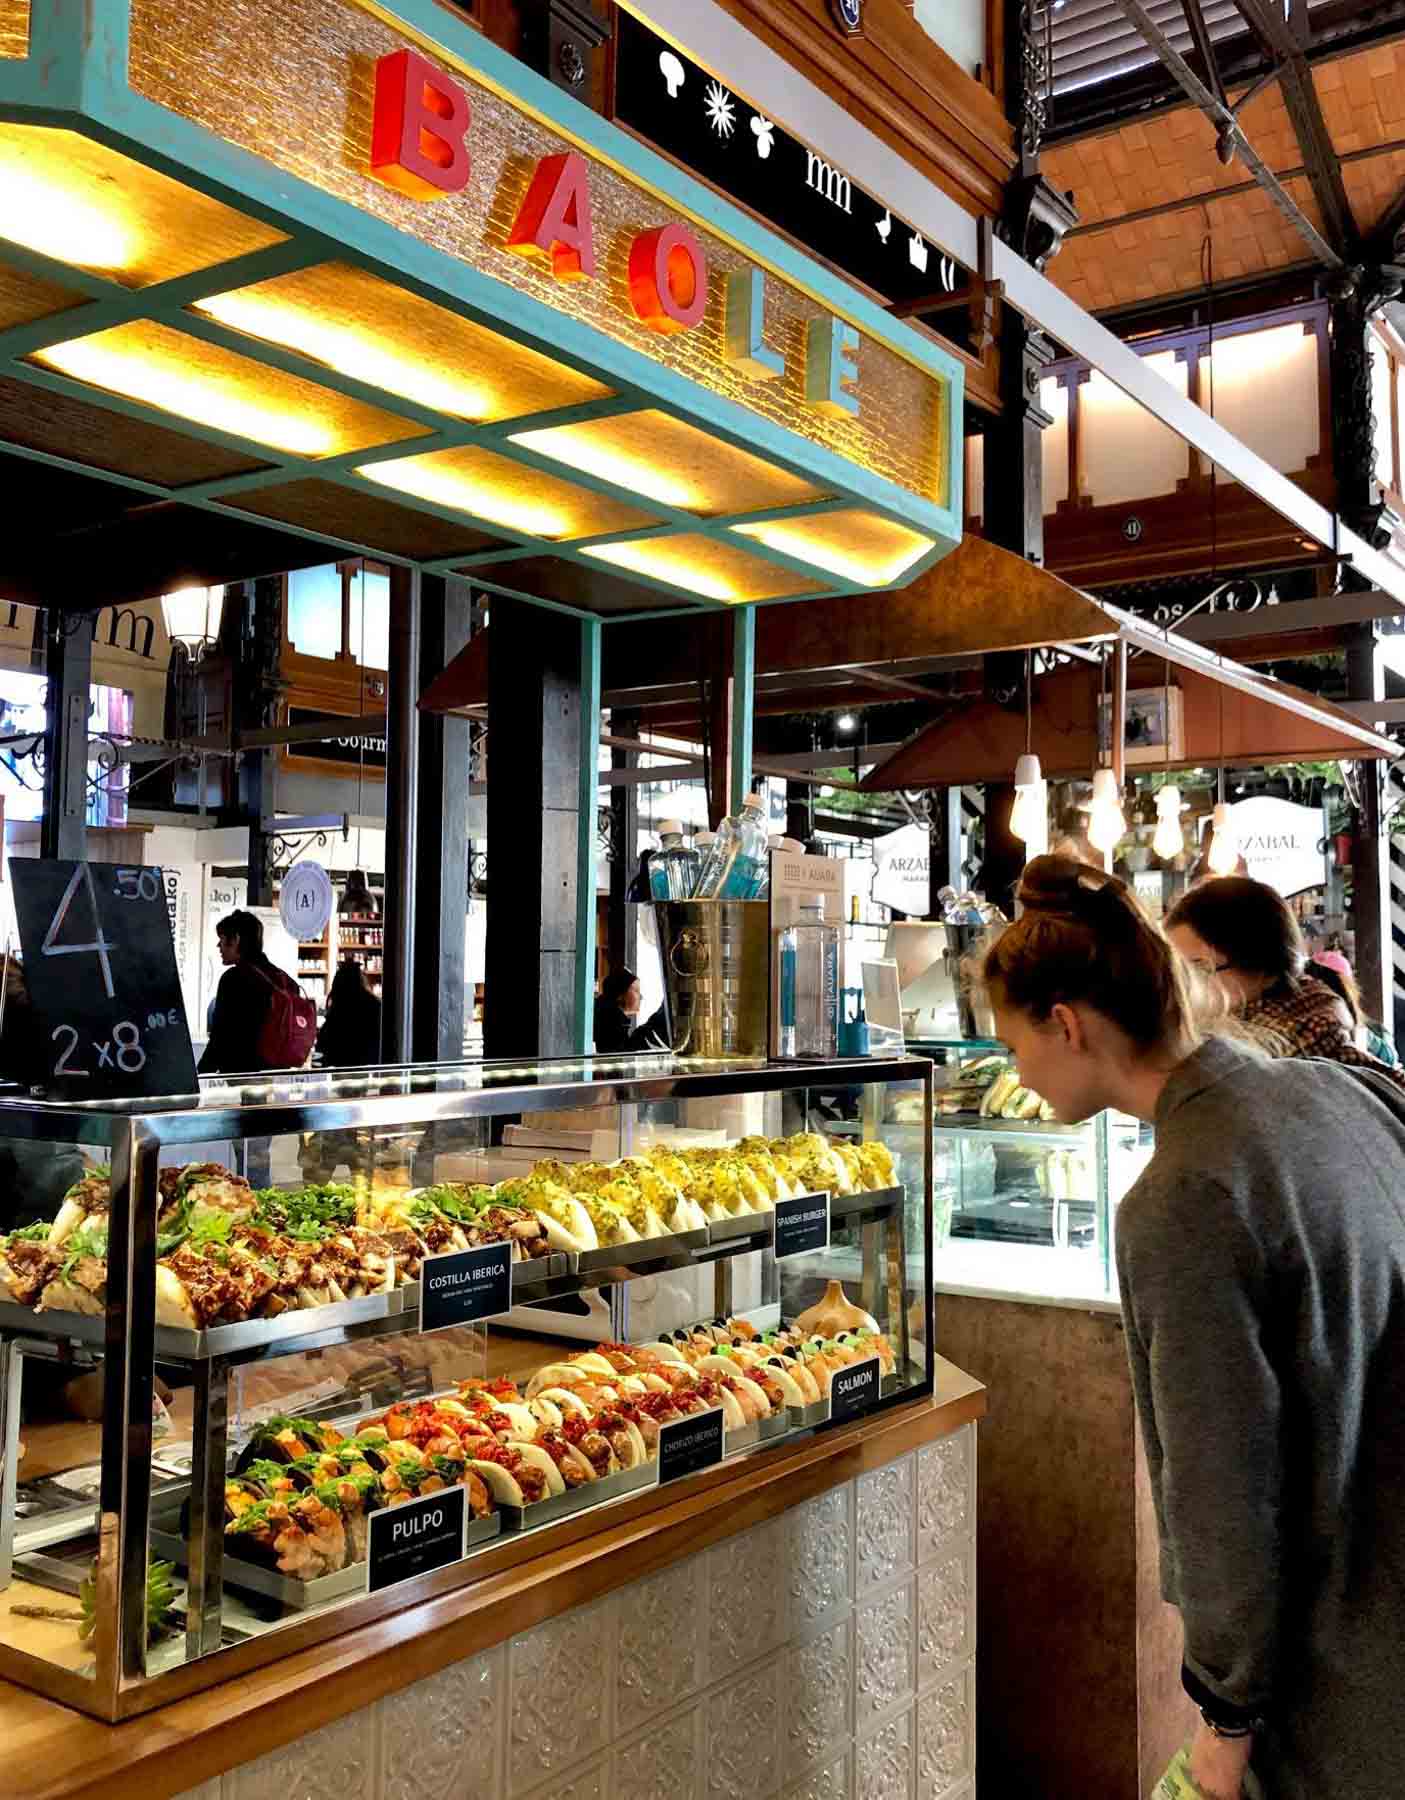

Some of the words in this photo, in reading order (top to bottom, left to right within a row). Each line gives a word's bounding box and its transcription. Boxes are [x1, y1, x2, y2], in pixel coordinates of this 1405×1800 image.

[429, 1271, 471, 1290] COSTILLA
[472, 1263, 506, 1281] IBERICA
[837, 1369, 873, 1395] SALMON
[392, 1508, 444, 1543] PULPO
